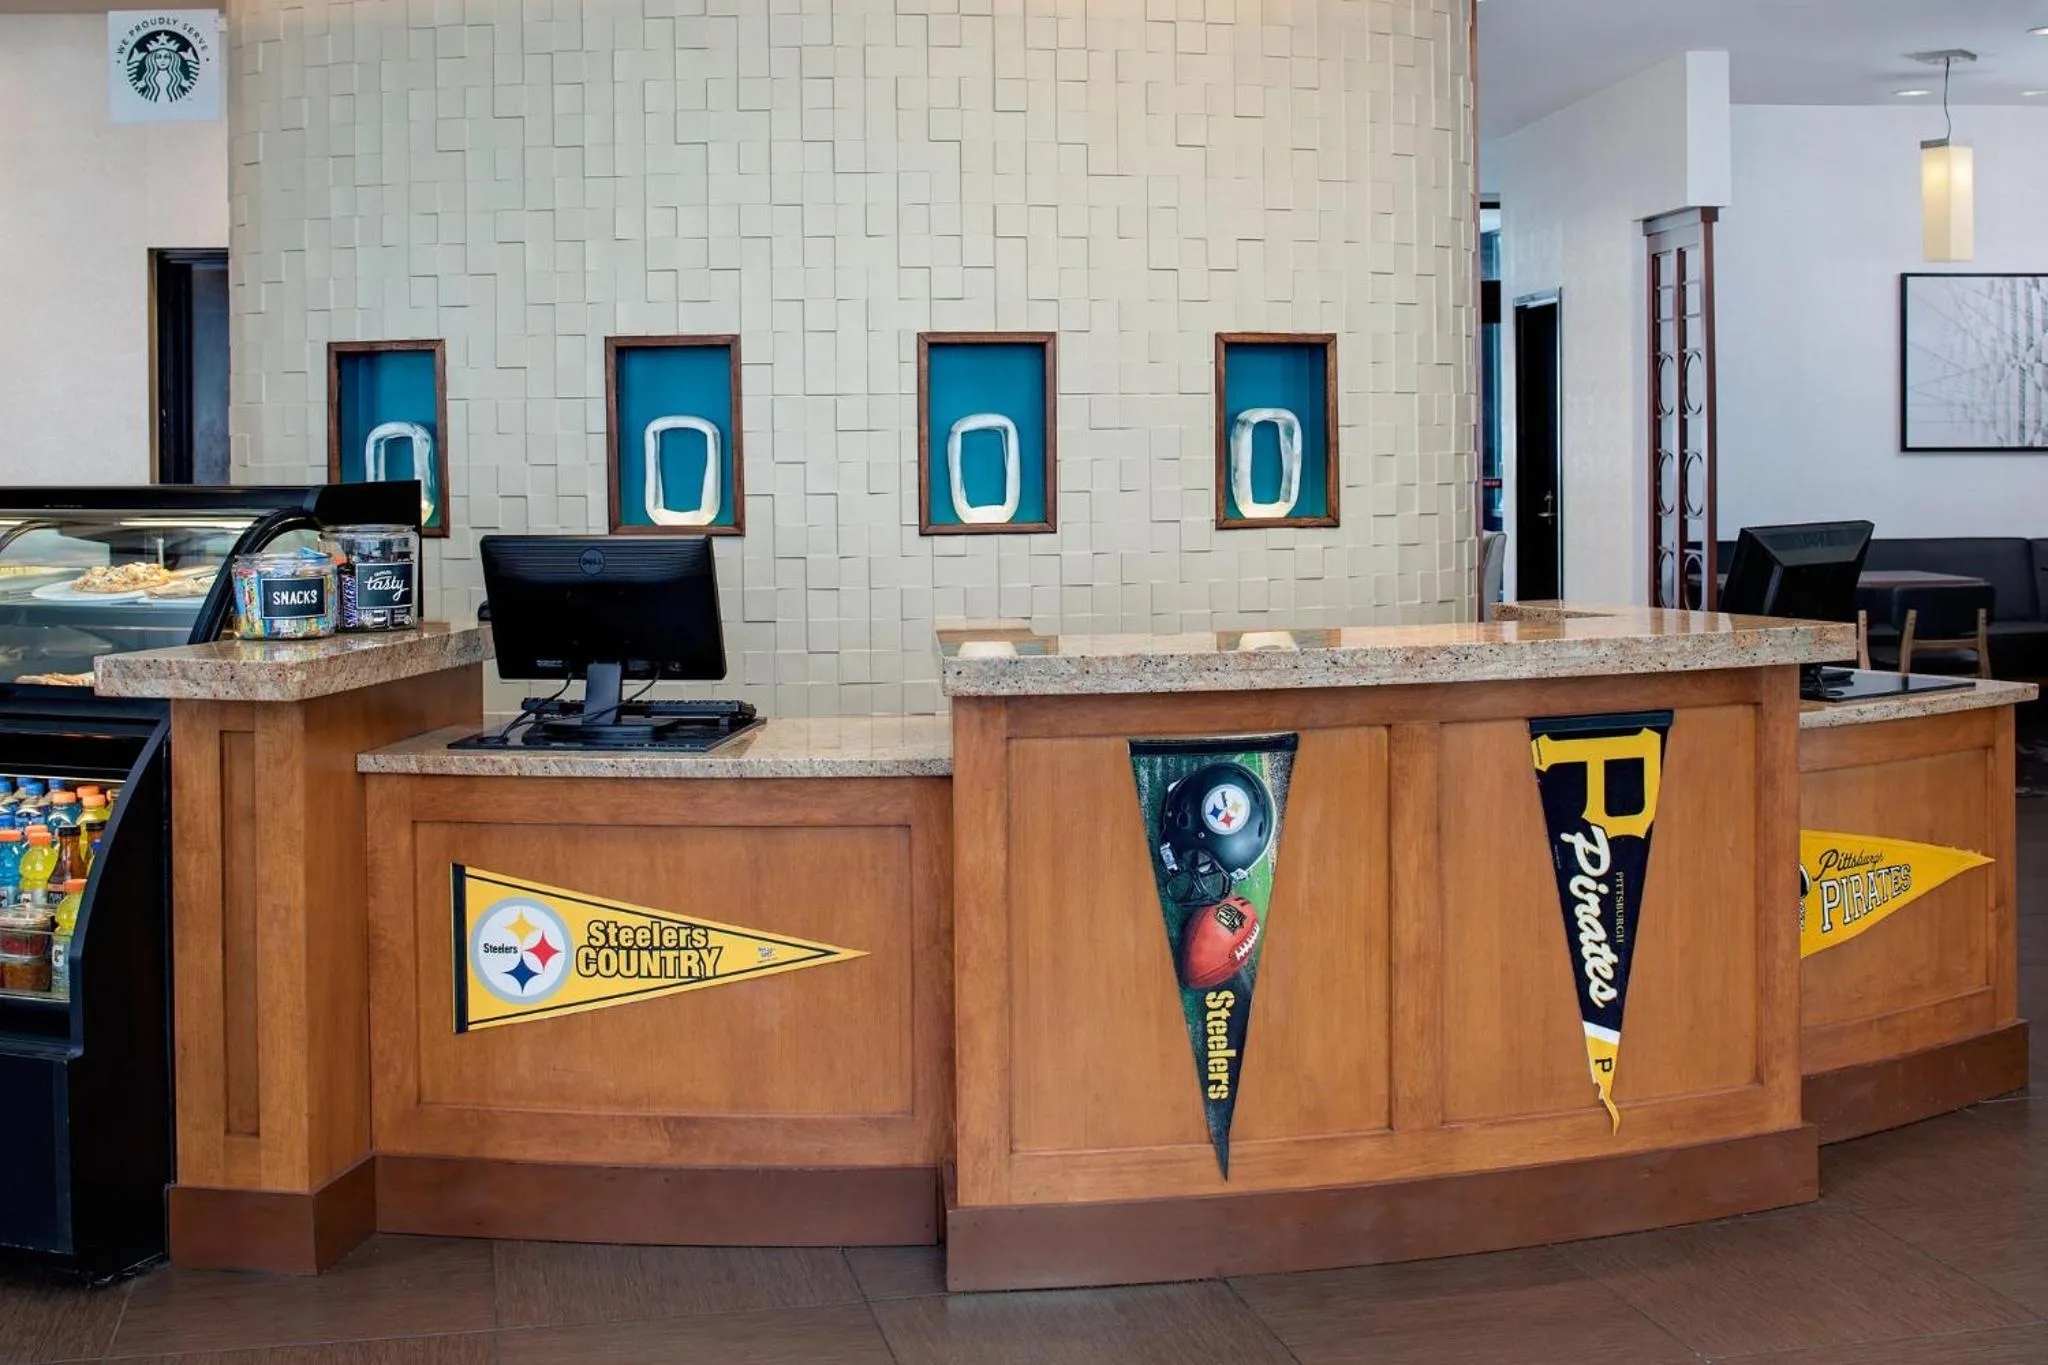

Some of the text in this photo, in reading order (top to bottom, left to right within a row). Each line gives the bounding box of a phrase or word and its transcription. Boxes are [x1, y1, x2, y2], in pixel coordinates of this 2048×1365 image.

[116, 17, 208, 54] WE PROUDLY SERVE
[582, 556, 603, 566] DELL
[272, 589, 318, 606] SNACKS
[363, 575, 409, 601] tasty
[1531, 726, 1662, 841] P
[1812, 848, 1885, 882] Pittsburgh
[1615, 871, 1625, 944] PITTSBURGH
[1820, 863, 1912, 934] PIRATES
[1560, 824, 1619, 1008] Pirates
[483, 942, 518, 954] Steelers
[587, 919, 708, 949] Steelers
[576, 945, 722, 980] COUNTRY
[1204, 990, 1236, 1101] Steelers
[1595, 1057, 1613, 1073] P
